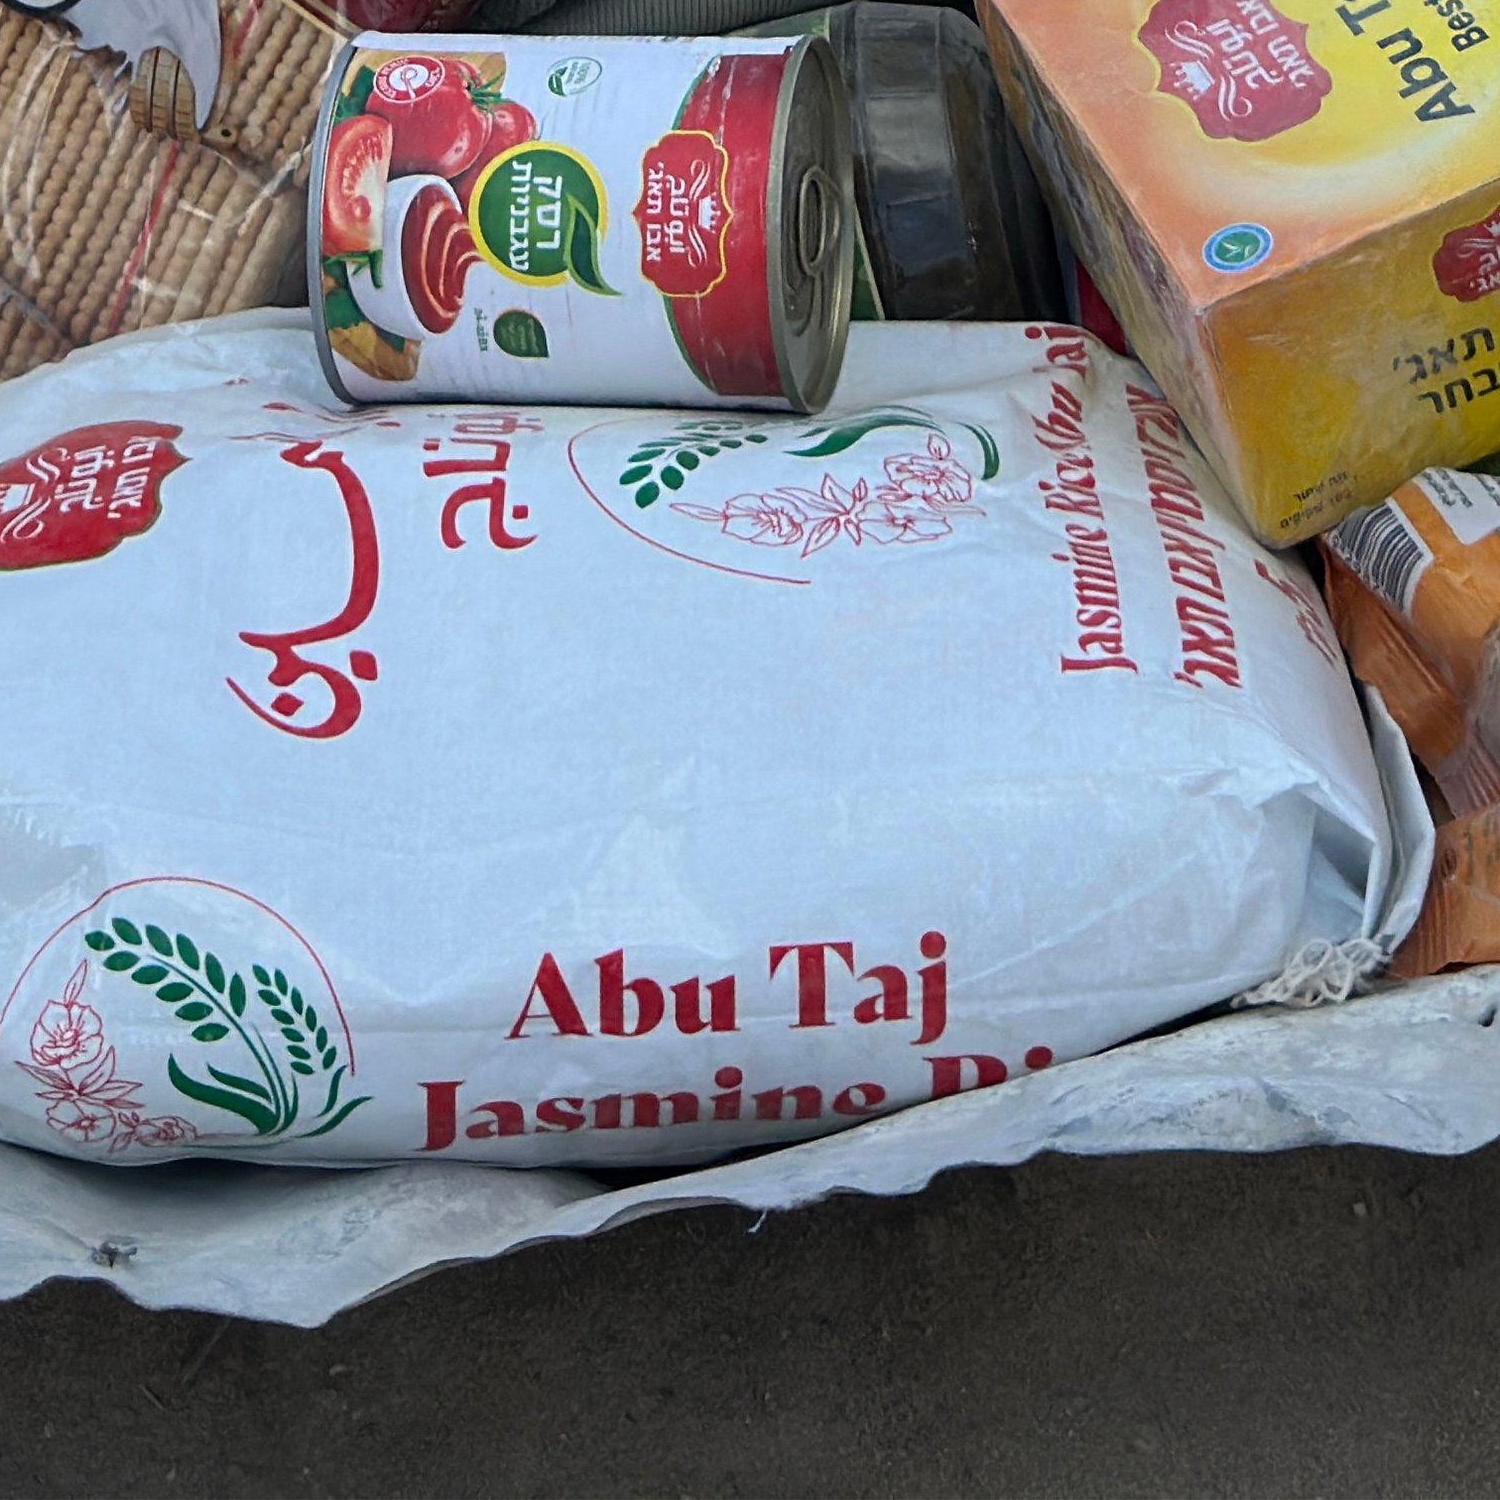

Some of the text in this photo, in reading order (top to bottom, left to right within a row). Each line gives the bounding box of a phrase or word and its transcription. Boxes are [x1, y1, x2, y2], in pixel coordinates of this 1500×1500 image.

[1376, 27, 1474, 121] Abu
[507, 159, 534, 270] עגבניות
[530, 175, 563, 249] רסק
[644, 222, 662, 261] אבו
[1038, 455, 1104, 519] Rice
[1050, 519, 1138, 672] Jasmine
[1160, 531, 1224, 602] אבו
[504, 930, 948, 1046] Abu Taj
[415, 1065, 887, 1152] Jasmine
